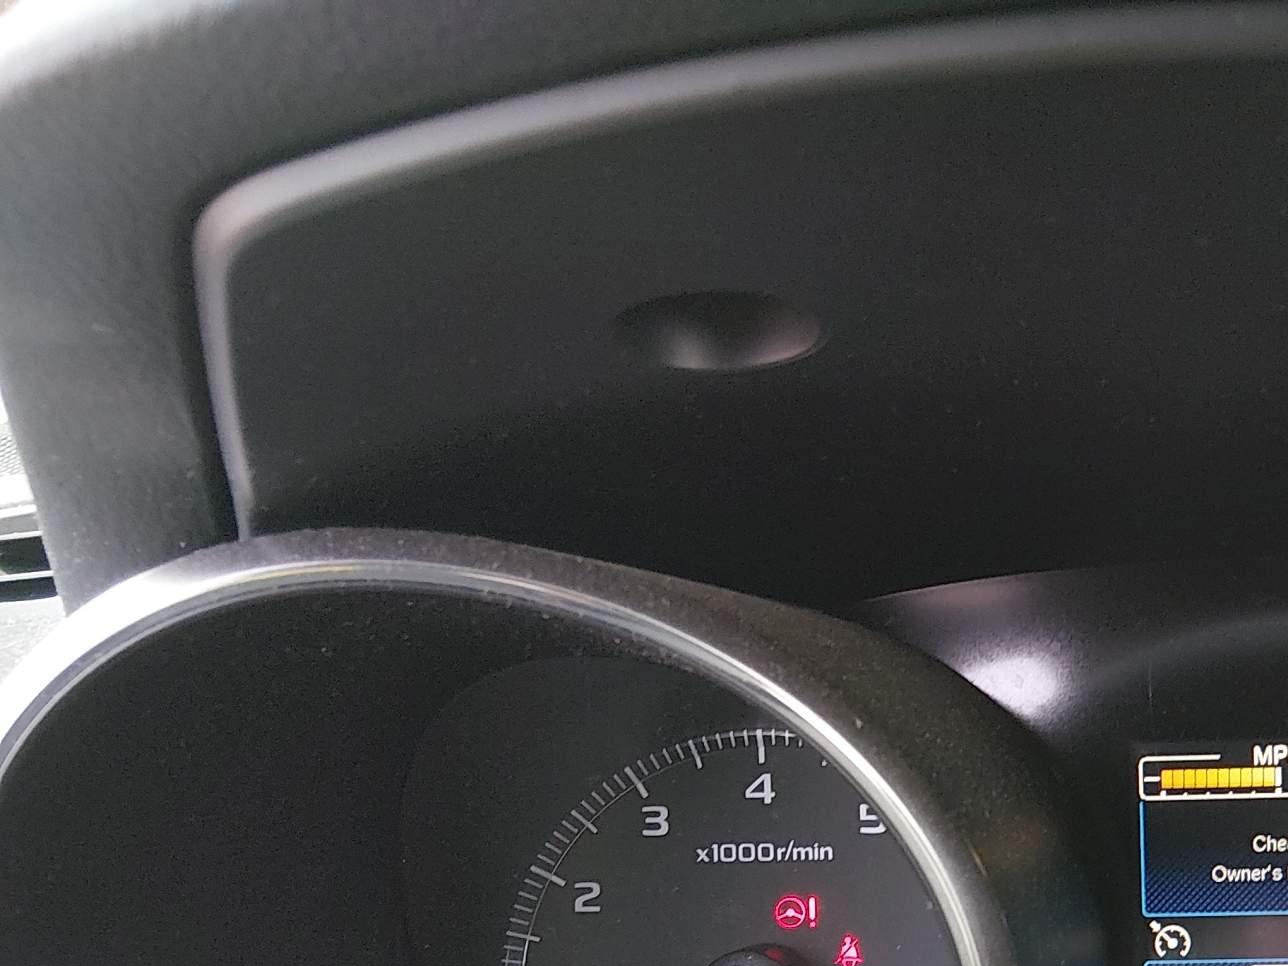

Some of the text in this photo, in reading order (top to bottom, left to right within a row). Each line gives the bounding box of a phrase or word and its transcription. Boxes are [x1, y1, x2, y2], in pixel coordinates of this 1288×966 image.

[746, 774, 775, 804] 4
[642, 806, 668, 836] 3
[860, 803, 887, 834] 5
[1212, 865, 1283, 882] Owner's
[575, 882, 600, 912] 2
